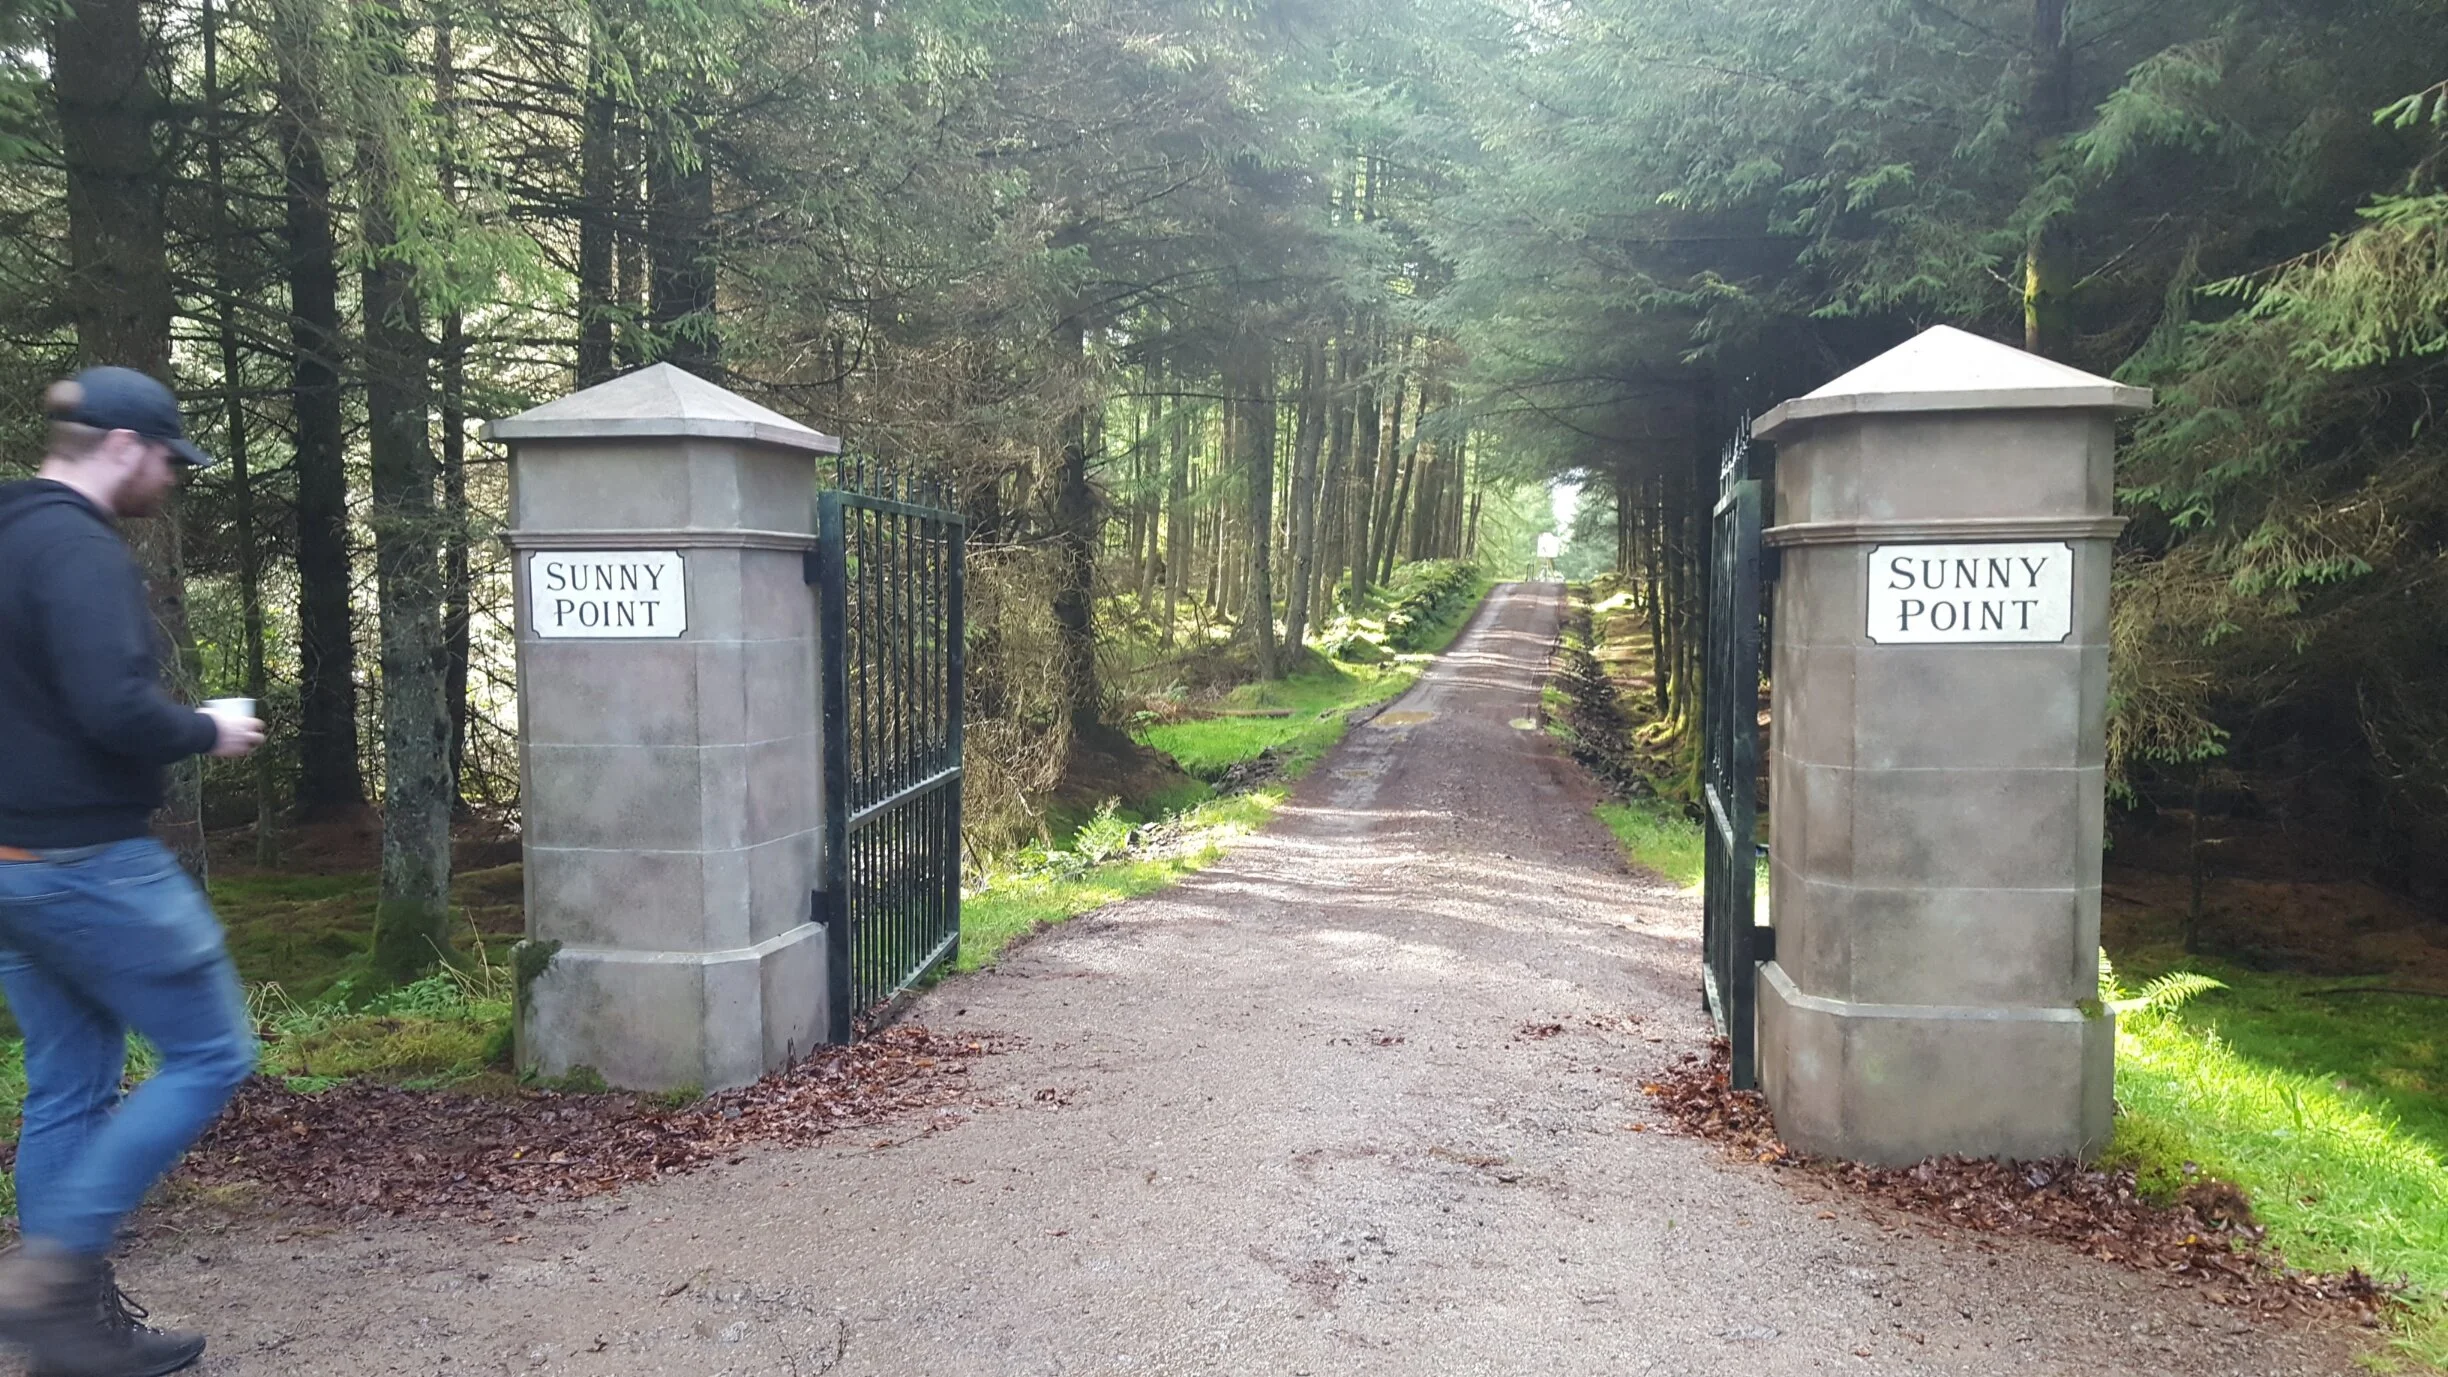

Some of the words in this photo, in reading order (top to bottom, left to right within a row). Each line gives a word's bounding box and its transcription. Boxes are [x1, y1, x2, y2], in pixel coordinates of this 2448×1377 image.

[546, 562, 665, 591] SUNNY
[1888, 557, 2049, 590] SUNNY
[554, 599, 660, 627] POINT
[1897, 599, 2039, 631] POINT
